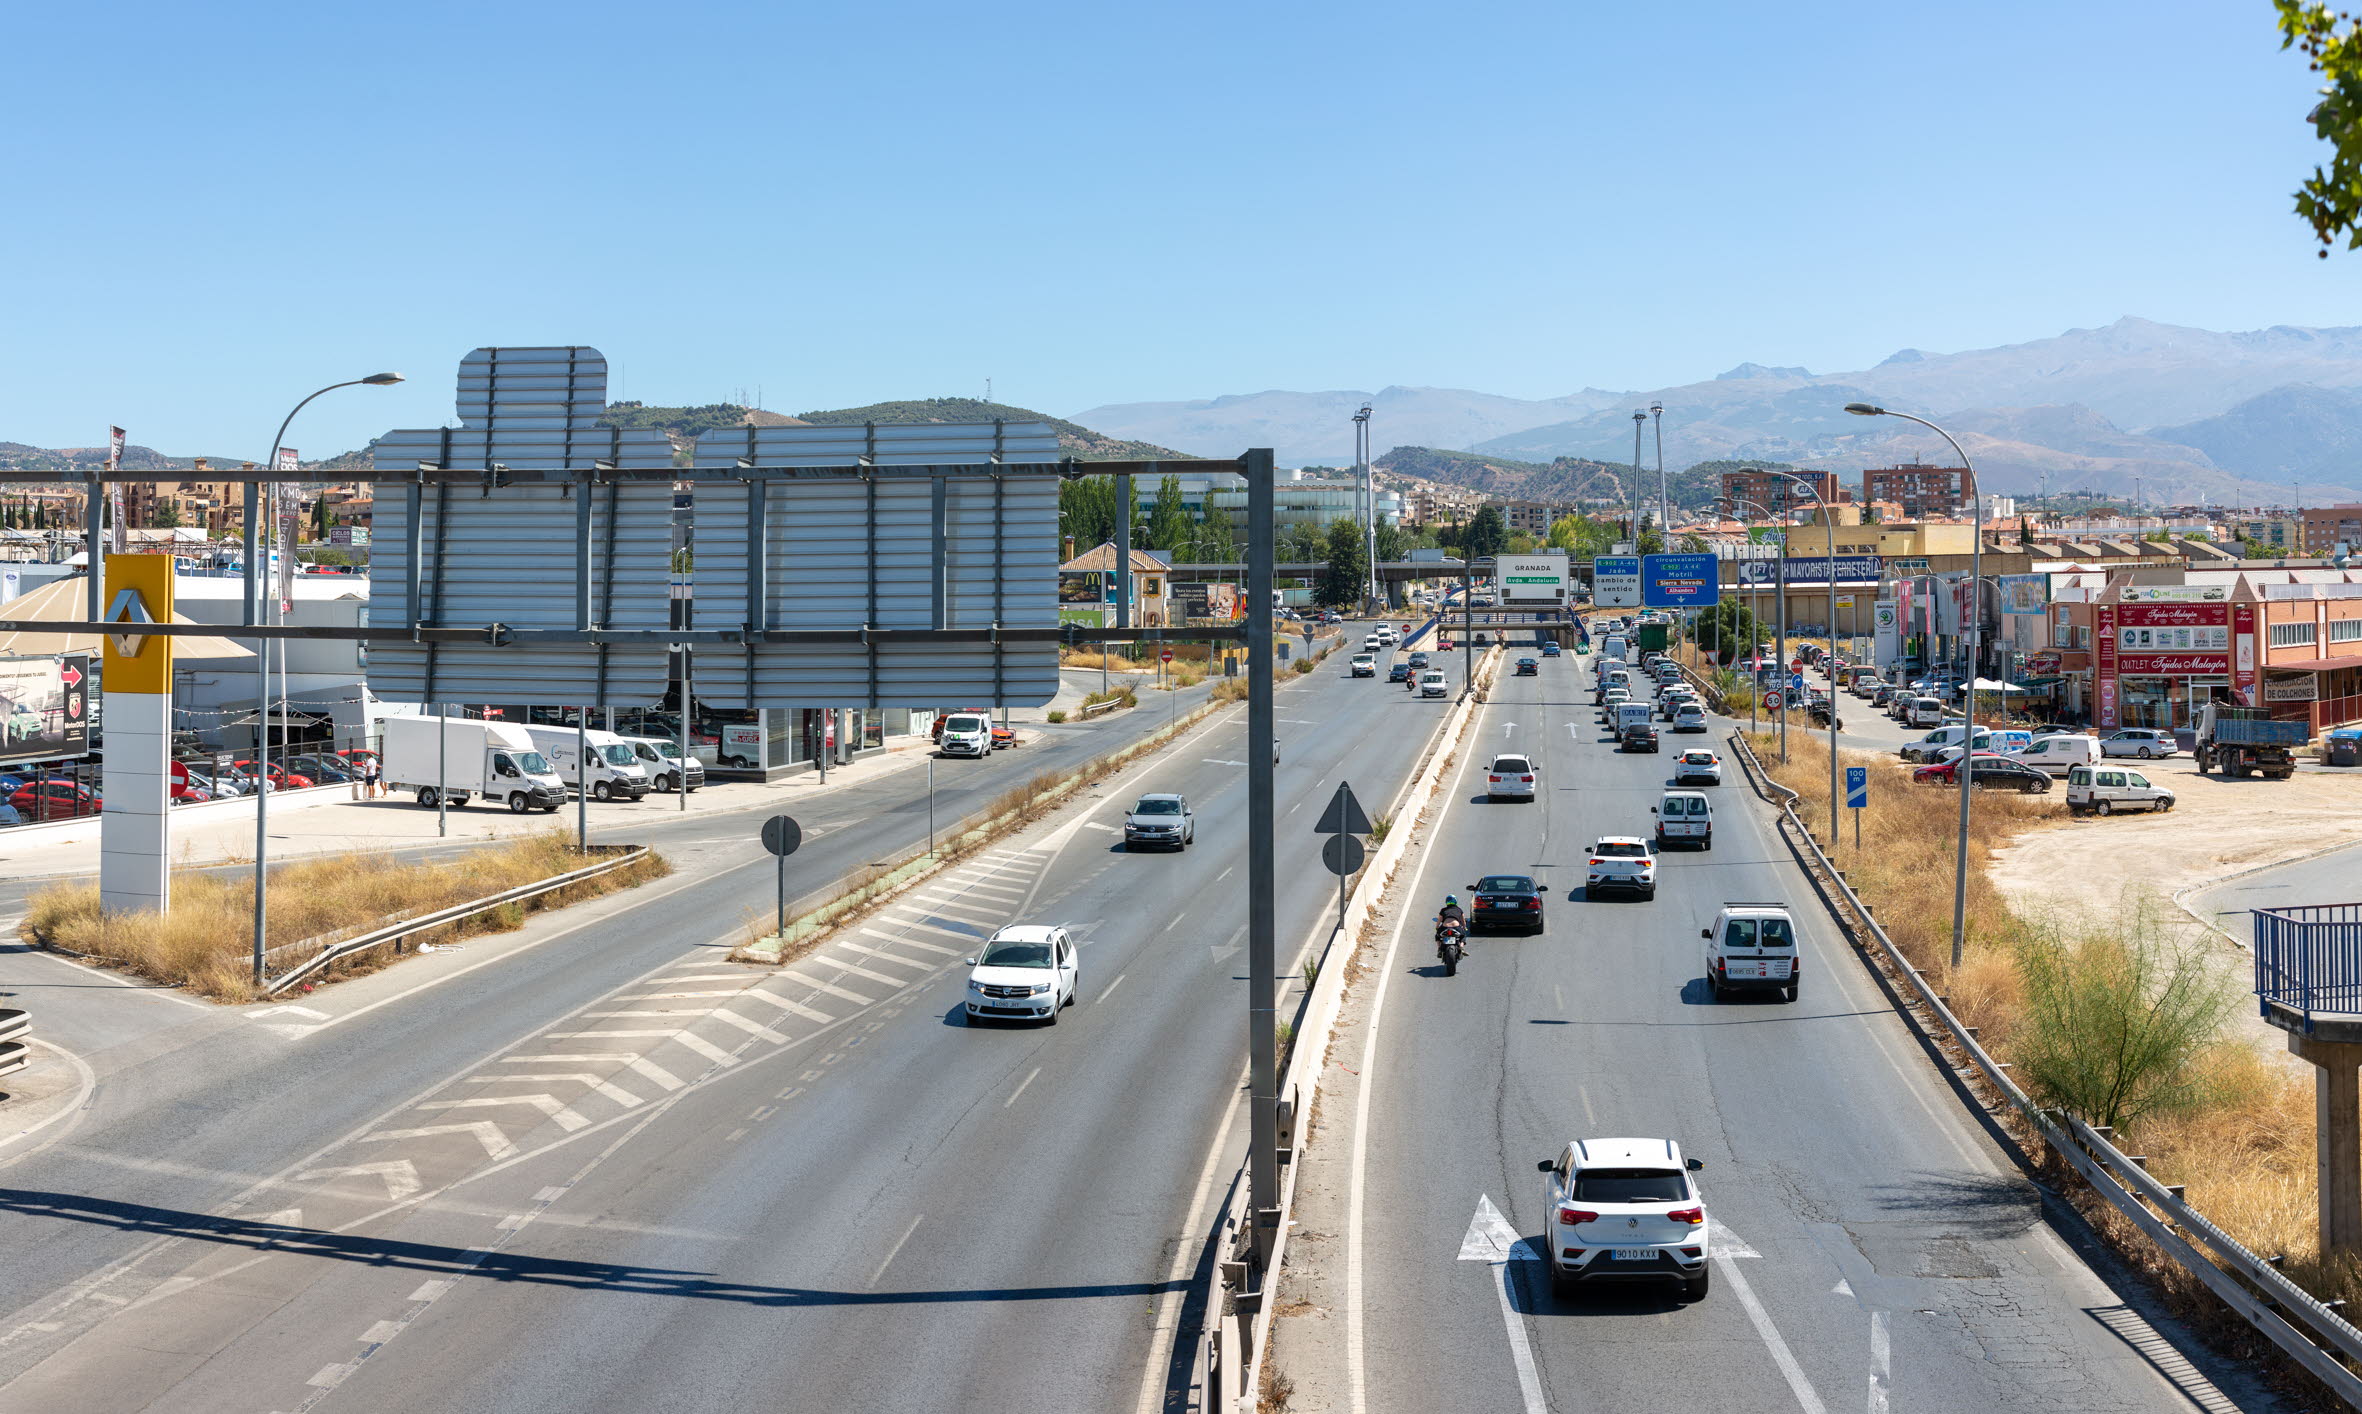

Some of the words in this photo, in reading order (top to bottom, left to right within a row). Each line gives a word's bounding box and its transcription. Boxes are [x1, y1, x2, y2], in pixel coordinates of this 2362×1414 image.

[1769, 562, 1788, 578] CH
[2147, 609, 2169, 620] Tejidos
[2169, 609, 2198, 620] Malagón
[2121, 660, 2149, 670] OUTLET
[2151, 656, 2183, 673] Tejidos
[2183, 656, 2227, 673] Malagón
[2267, 690, 2276, 698] DE
[2277, 688, 2315, 698] COLCHONES
[1616, 1250, 1638, 1258] 9010
[1639, 1250, 1657, 1258] KXX
